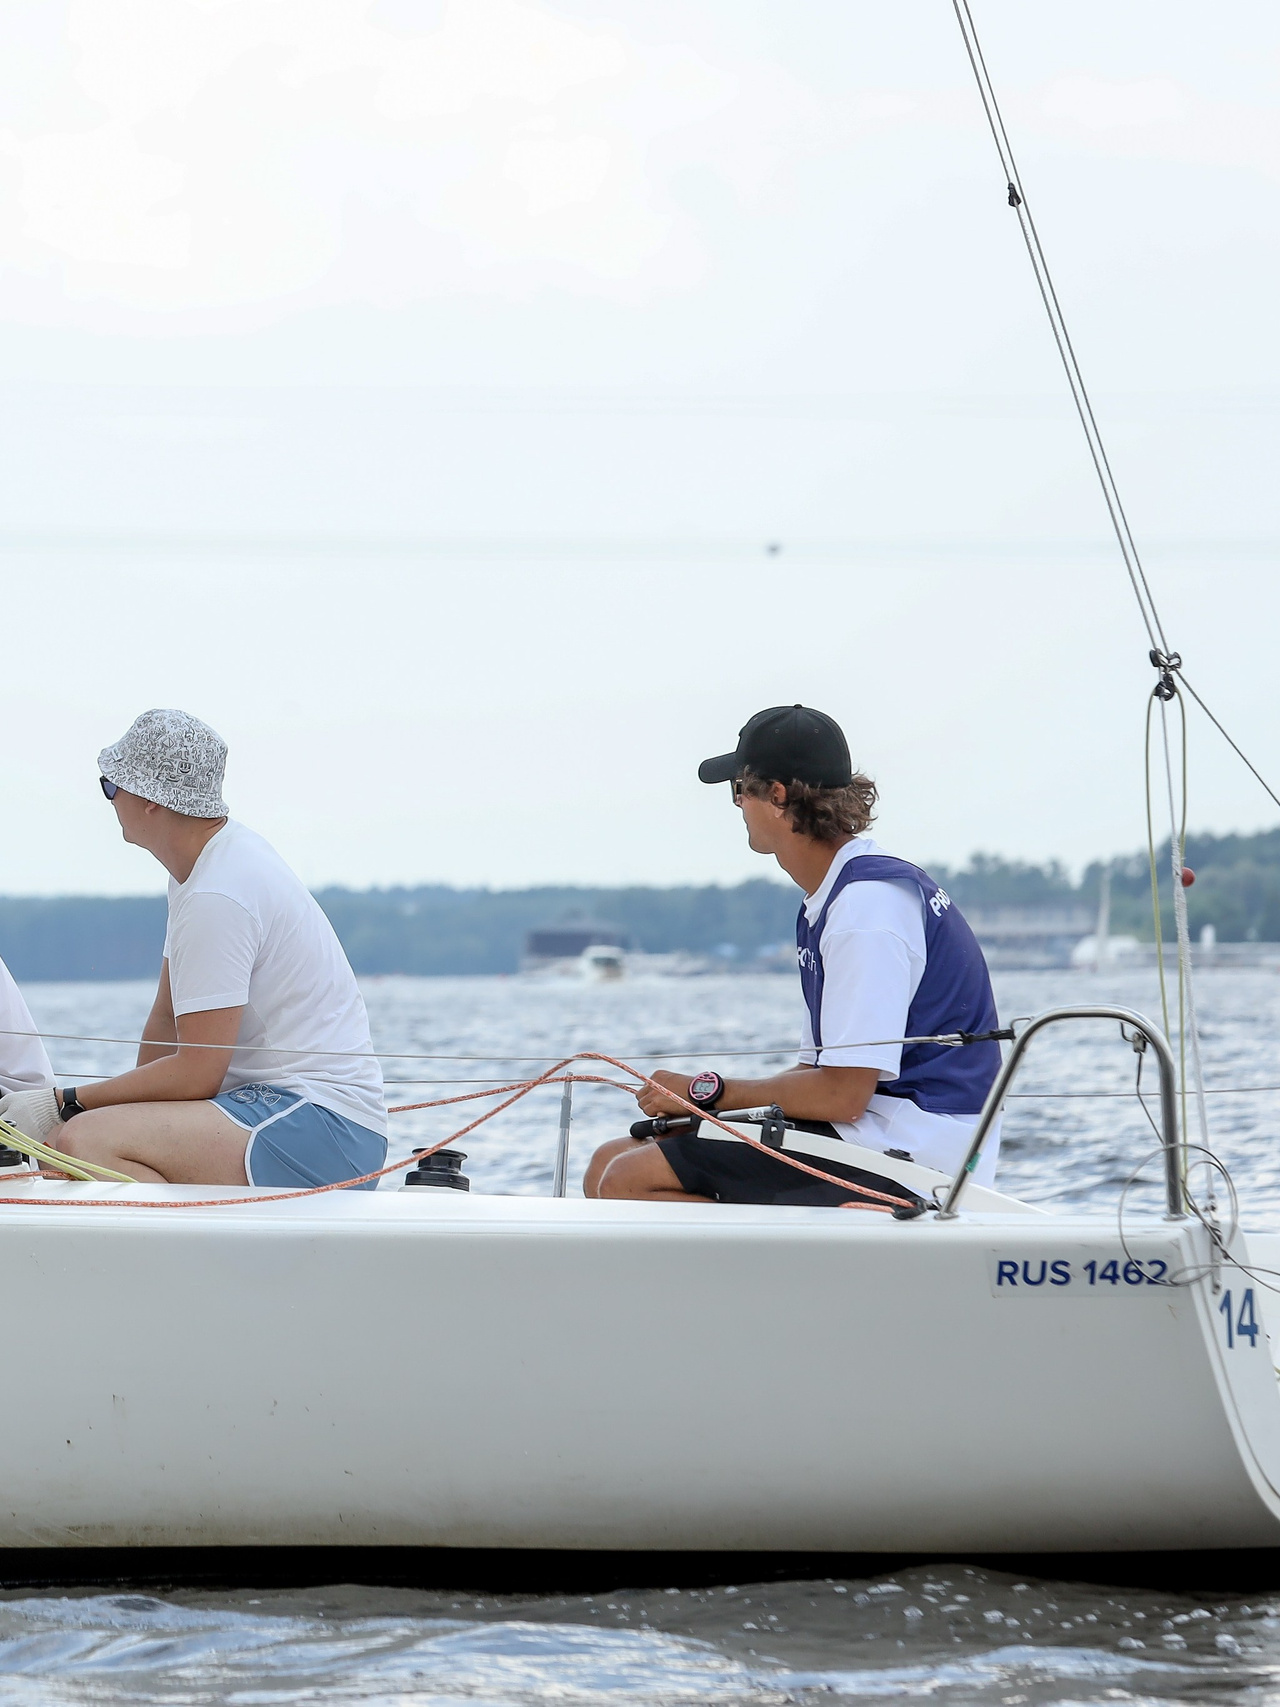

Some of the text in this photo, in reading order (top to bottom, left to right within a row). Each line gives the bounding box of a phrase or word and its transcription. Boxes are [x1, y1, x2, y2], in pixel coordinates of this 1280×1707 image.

[996, 1259, 1169, 1287] RUS 1462
[1220, 1288, 1259, 1350] 14
